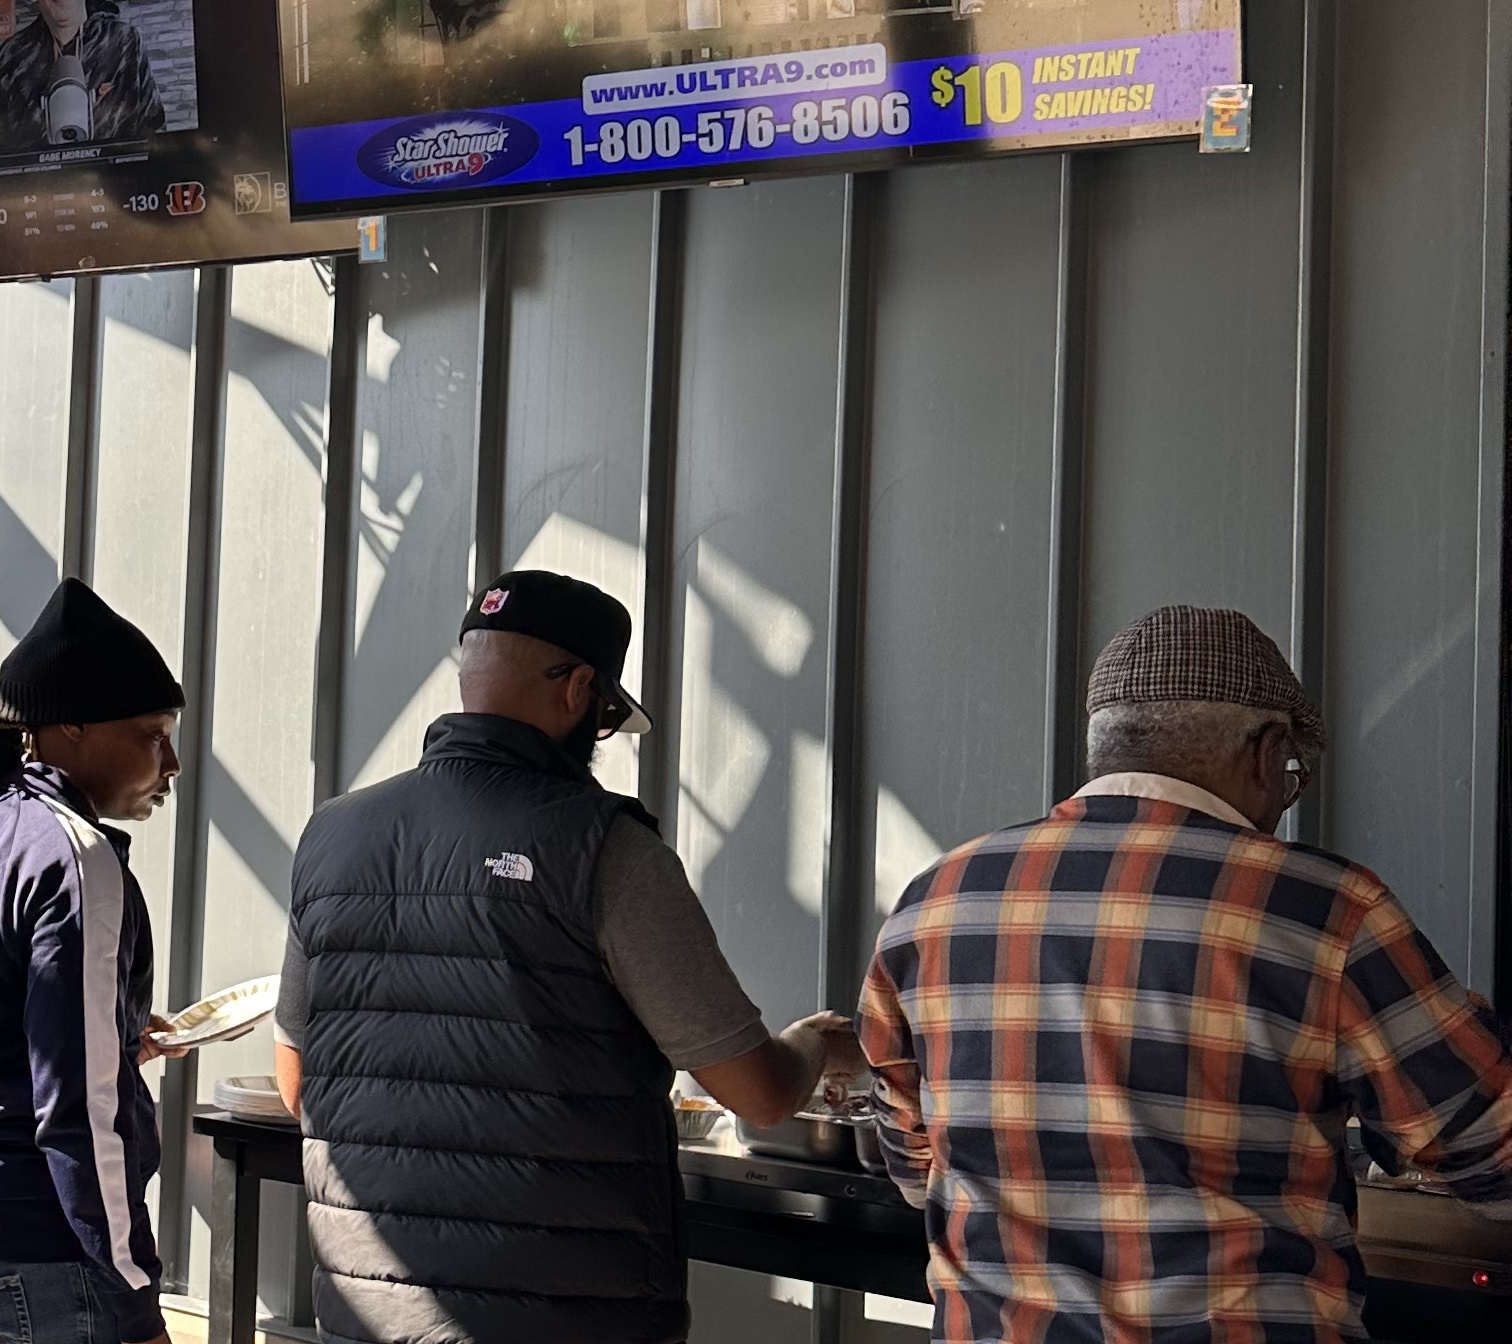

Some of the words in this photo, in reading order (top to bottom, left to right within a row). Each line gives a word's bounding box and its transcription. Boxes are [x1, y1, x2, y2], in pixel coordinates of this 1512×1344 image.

[590, 57, 876, 105] www.ULTRA9.com
[1032, 48, 1141, 84] INSTANT
[930, 61, 1022, 126] $10
[1033, 84, 1155, 121] SAVINGS!
[563, 91, 911, 166] 1-800-576-8506
[123, 193, 159, 212] -130
[364, 221, 378, 252] 1
[484, 858, 518, 872] NORTH
[492, 867, 518, 879] FACE
[501, 852, 521, 862] THE
